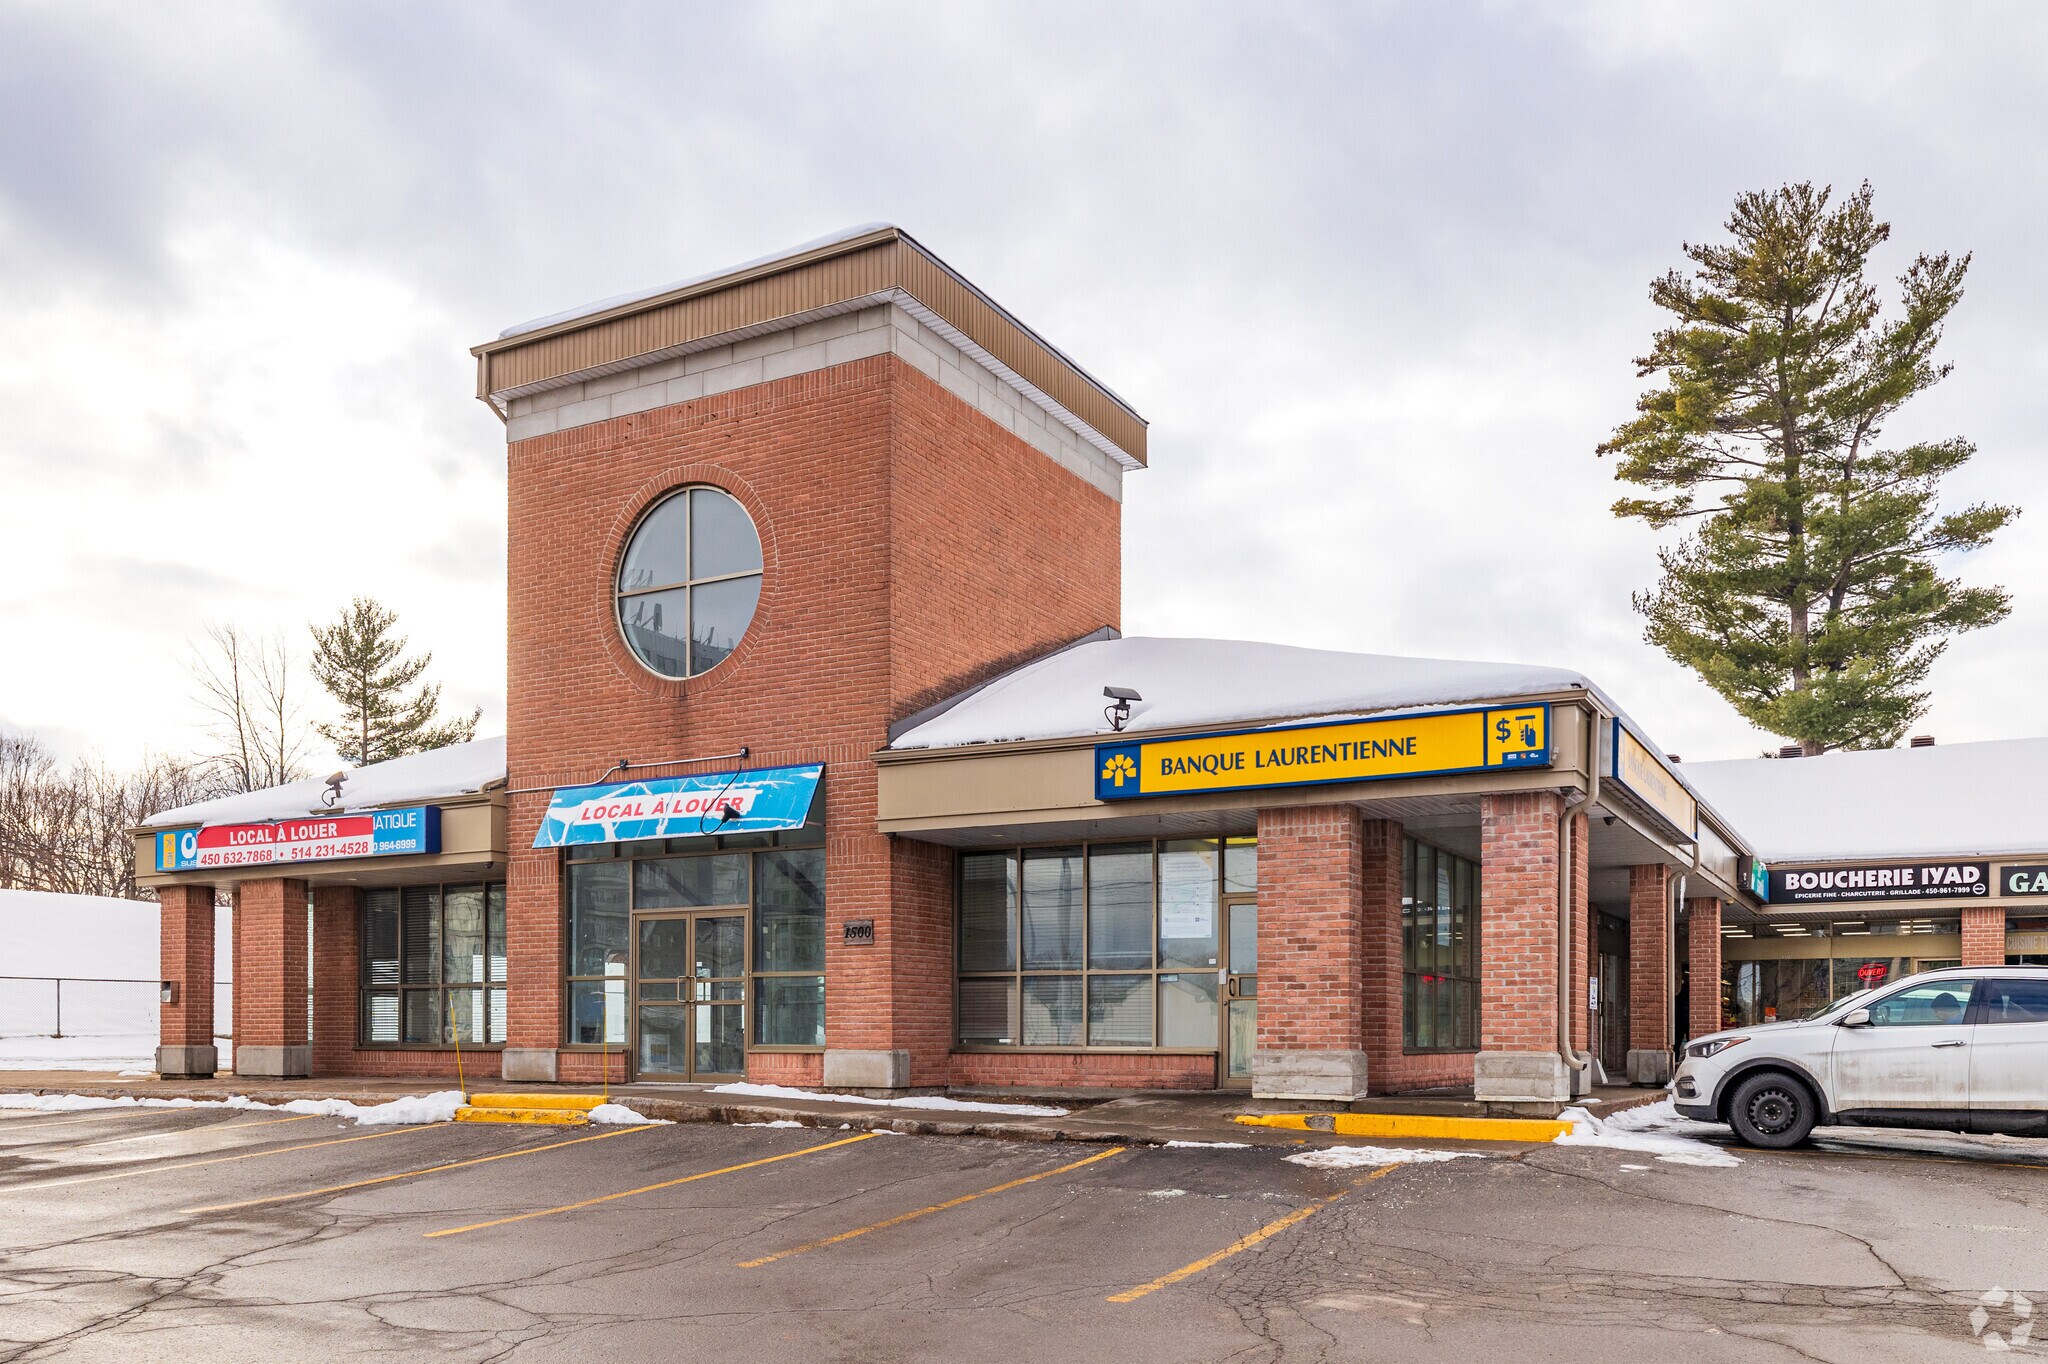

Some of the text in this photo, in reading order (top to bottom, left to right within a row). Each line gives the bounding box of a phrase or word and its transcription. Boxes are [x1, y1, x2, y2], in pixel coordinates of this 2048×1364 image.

[1496, 717, 1511, 743] $
[1161, 736, 1417, 776] BANQUE LAURENTIENNE
[581, 796, 744, 820] LOCAL À LOUER
[373, 812, 416, 831] ATIQUE
[229, 823, 338, 845] LOCAL À LOUER
[379, 839, 416, 851] 964-6999
[201, 841, 369, 866] 450 632-7868 514 231-4528
[1785, 868, 1914, 890] BOUCHERIE
[1921, 866, 1980, 885] IYAD
[2009, 871, 2048, 893] GA
[845, 926, 871, 939] 1500
[2007, 936, 2038, 950] CUISINE
[1859, 968, 1884, 977] OUVERT
